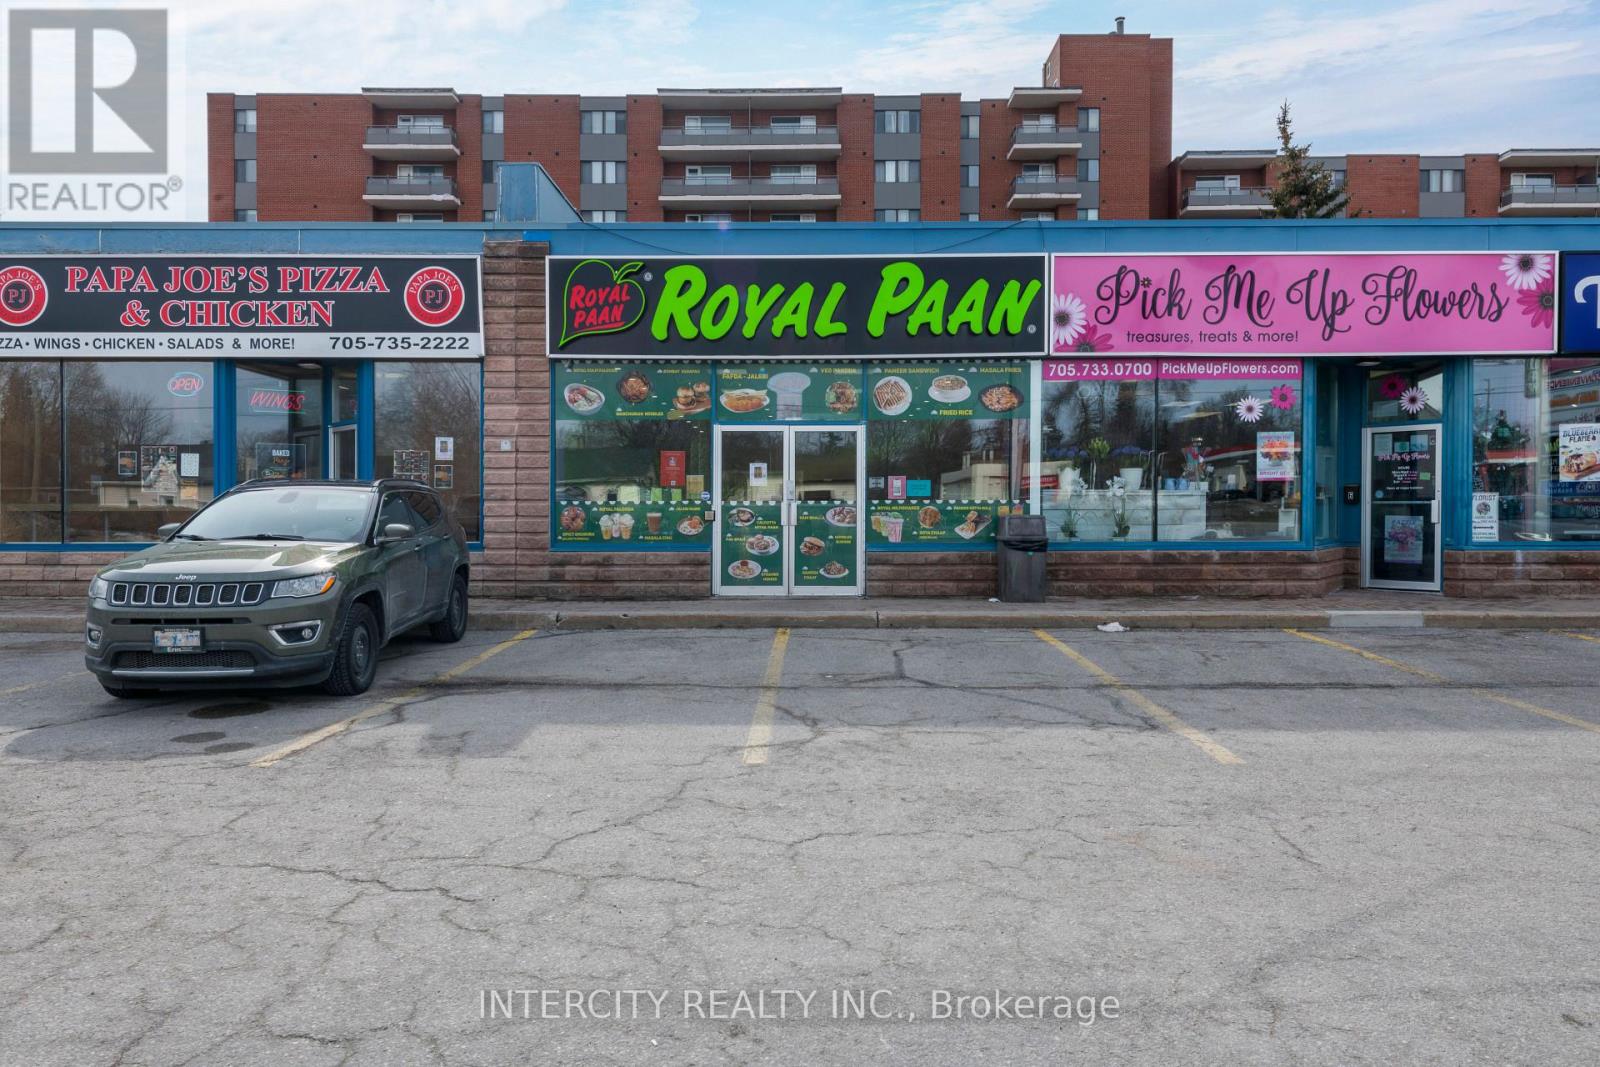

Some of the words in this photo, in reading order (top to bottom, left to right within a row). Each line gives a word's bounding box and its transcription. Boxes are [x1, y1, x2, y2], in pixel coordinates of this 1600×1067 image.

[65, 266, 158, 293] PAPA
[163, 266, 269, 293] JOE'S
[277, 266, 390, 293] PIZZA
[8, 288, 27, 304] PJ
[424, 289, 444, 304] PJ
[570, 283, 631, 310] ROYAL
[651, 264, 847, 340] ROYAL
[867, 261, 1042, 337] PAAN
[1094, 264, 1192, 325] Pick
[1203, 264, 1275, 328] Me
[1286, 267, 1355, 341] Up
[1361, 265, 1509, 326] Flowers
[120, 300, 151, 327] &
[160, 300, 335, 327] CHICKEN
[574, 304, 624, 329] PAAN
[34, 338, 81, 350] WINGS
[92, 338, 155, 350] CHICKEN
[167, 338, 224, 350] SALADS
[232, 338, 242, 350] &
[250, 338, 295, 350] MORE!
[329, 336, 470, 350] 705-735-2222
[1126, 331, 1193, 344] treasures,
[1199, 331, 1238, 343] treats
[1243, 331, 1253, 343] &
[1258, 331, 1299, 343] more!
[1049, 362, 1152, 377] 705.733.0700
[1162, 362, 1299, 376] PickMeUpFlowers.com
[170, 377, 201, 392] OPEN
[249, 391, 305, 411] WINGS
